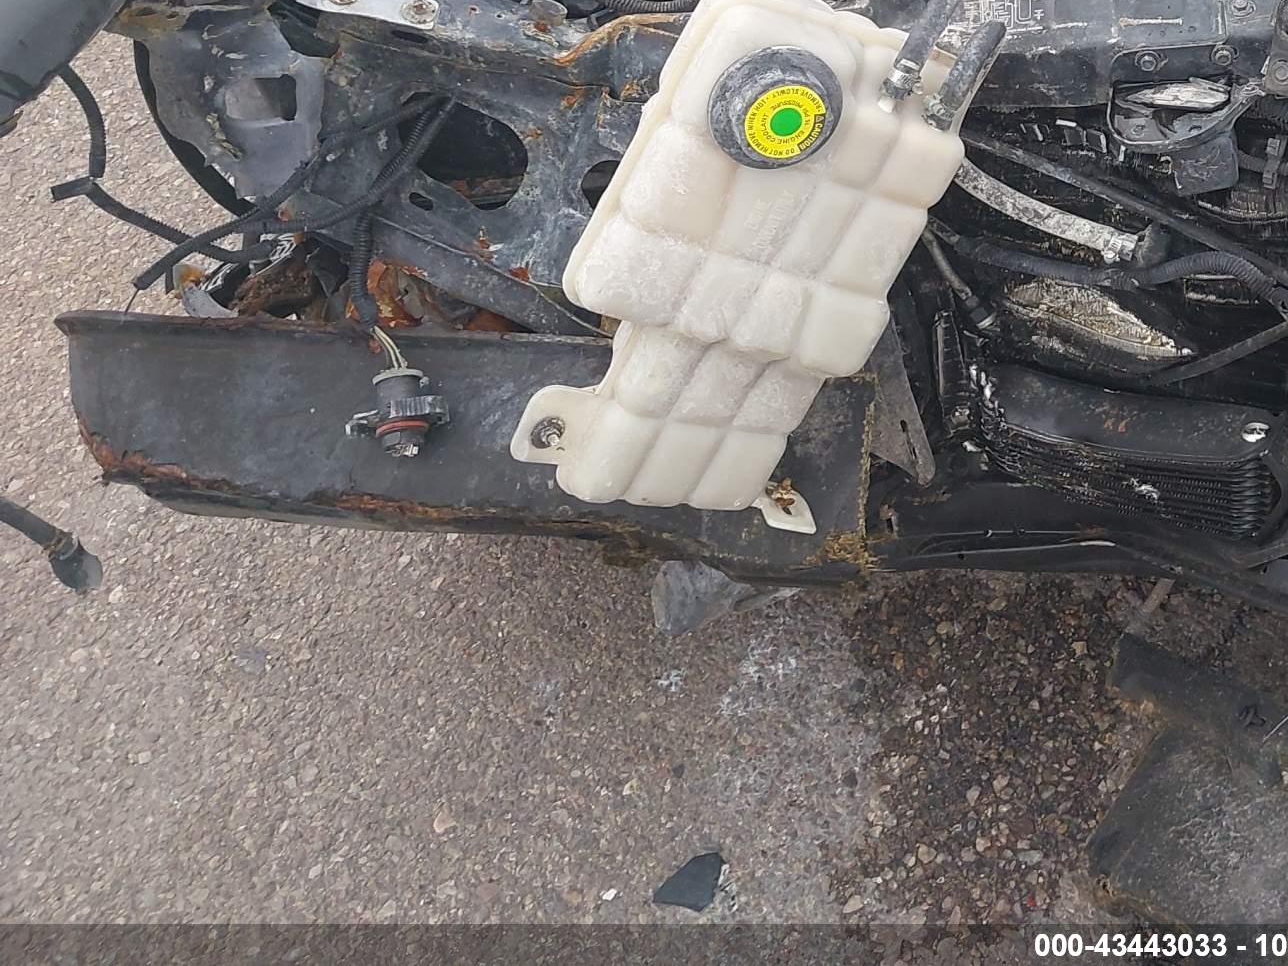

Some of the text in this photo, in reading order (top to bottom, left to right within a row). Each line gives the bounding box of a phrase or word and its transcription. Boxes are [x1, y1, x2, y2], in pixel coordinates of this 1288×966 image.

[772, 89, 799, 98] SLOWLY
[754, 99, 766, 111] HOT
[748, 112, 757, 130] WHEN
[761, 114, 805, 144] ENGINE COOLANT
[749, 132, 769, 153] REMOVE
[800, 124, 823, 150] CAUTION
